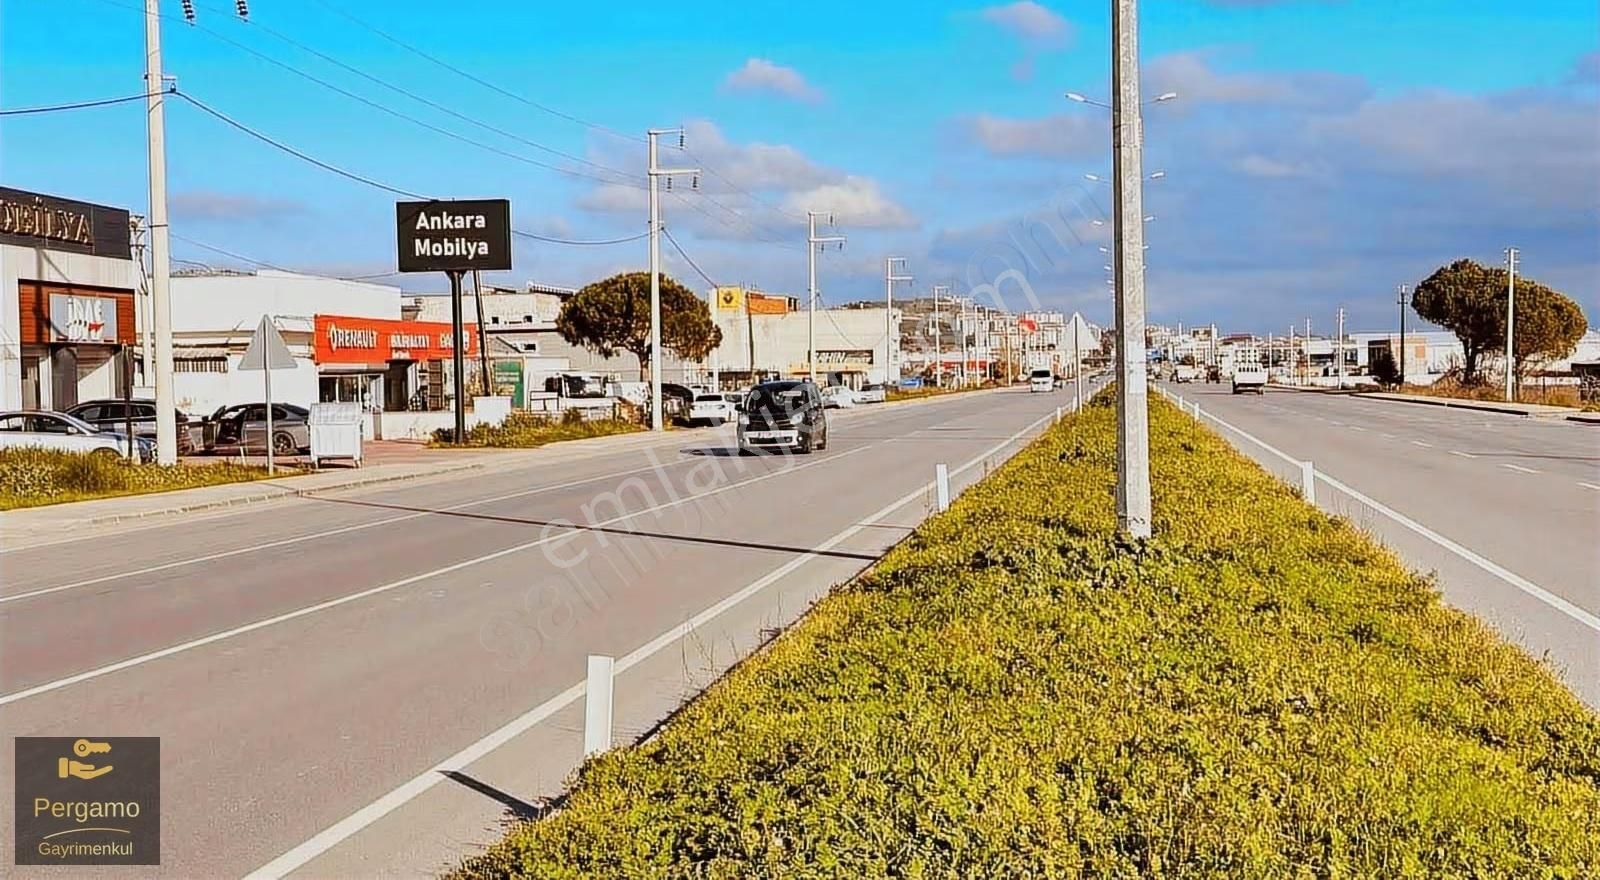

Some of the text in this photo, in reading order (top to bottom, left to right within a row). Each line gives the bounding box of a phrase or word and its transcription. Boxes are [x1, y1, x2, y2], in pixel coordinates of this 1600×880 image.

[416, 211, 486, 231] Ankara
[415, 237, 489, 259] Mobilya
[338, 327, 378, 349] RENAULT
